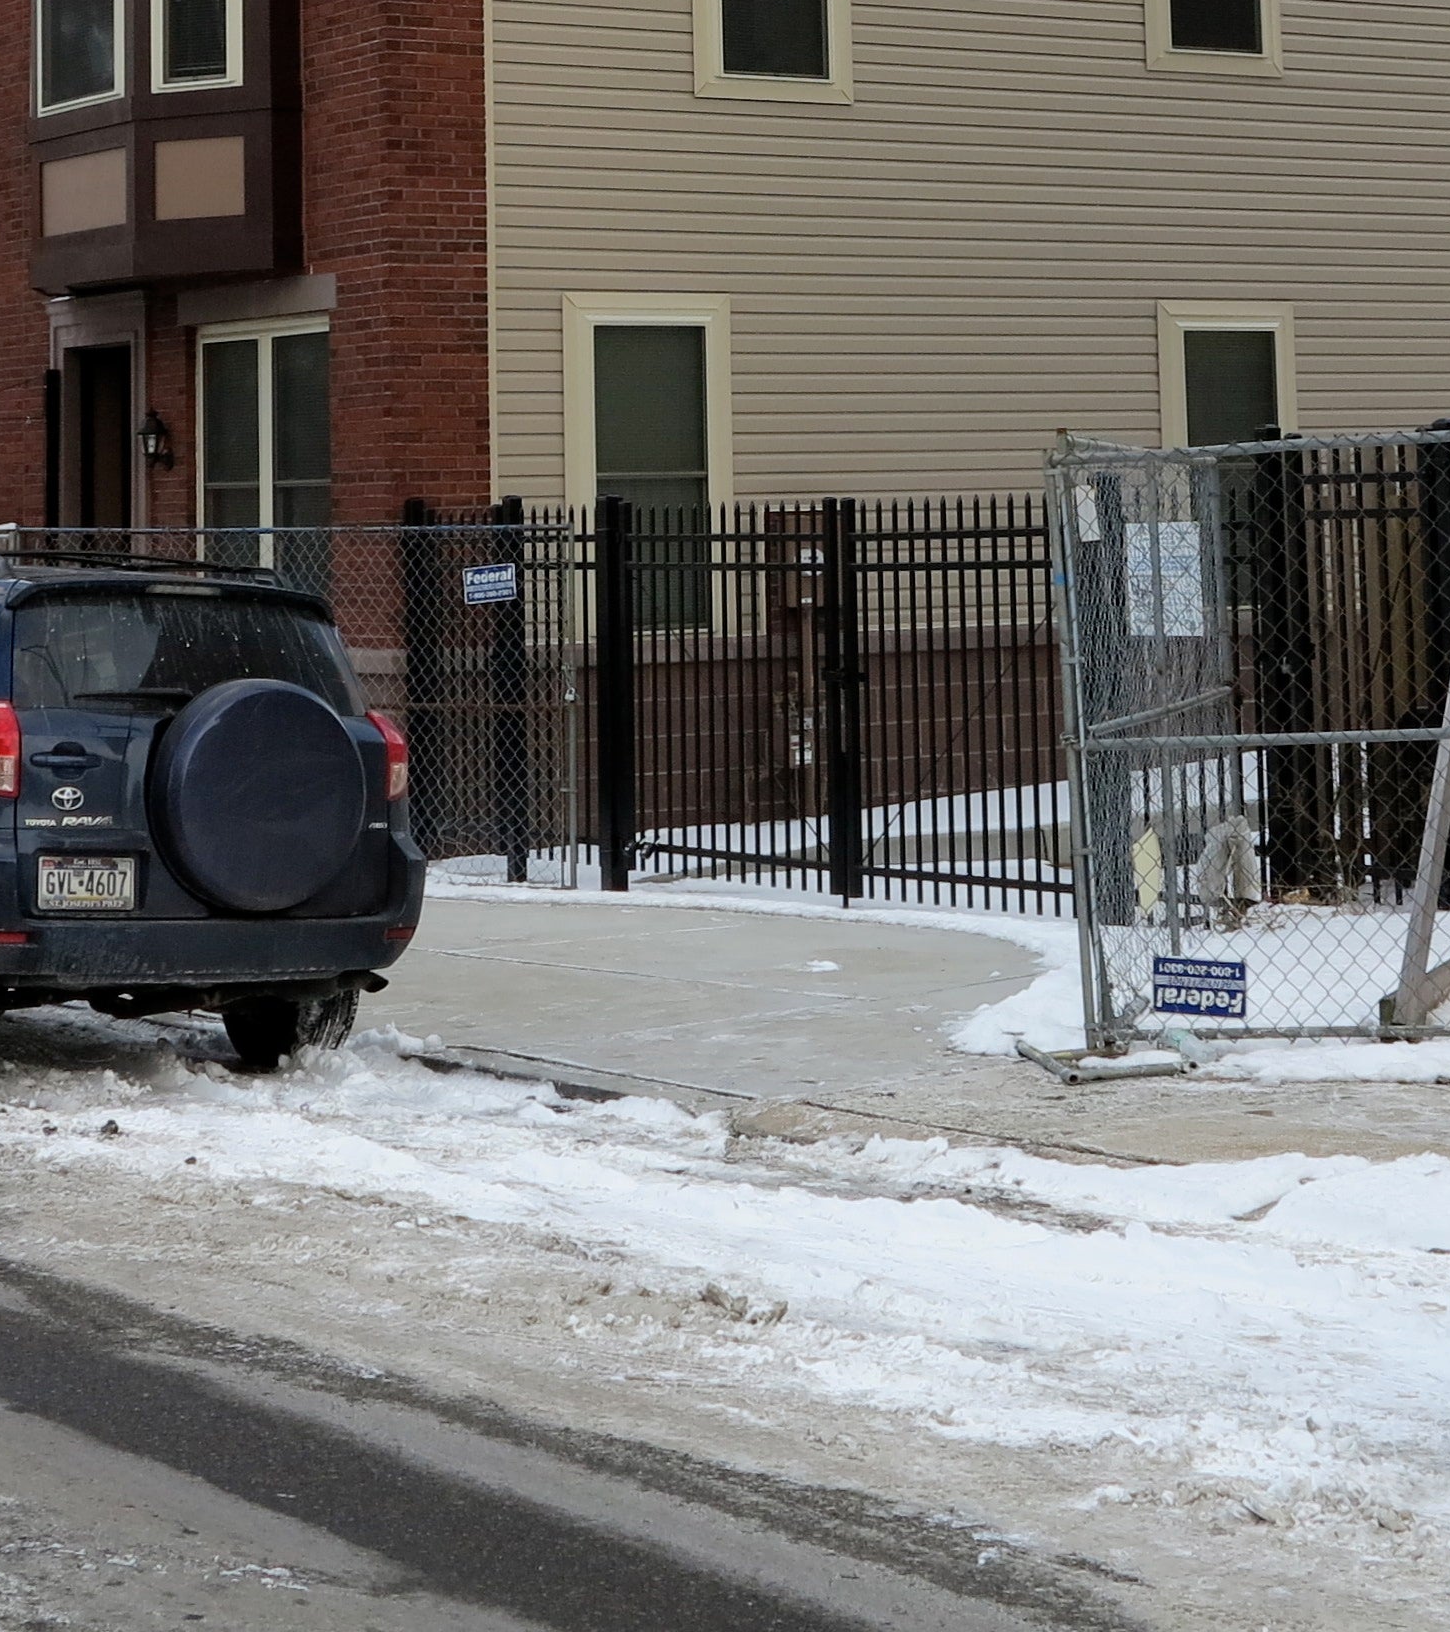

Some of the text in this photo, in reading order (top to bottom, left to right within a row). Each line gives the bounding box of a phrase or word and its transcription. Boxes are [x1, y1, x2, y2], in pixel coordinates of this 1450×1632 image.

[466, 567, 512, 585] Federal
[24, 818, 57, 827] TOYOTA
[1156, 987, 1243, 1014] Federal
